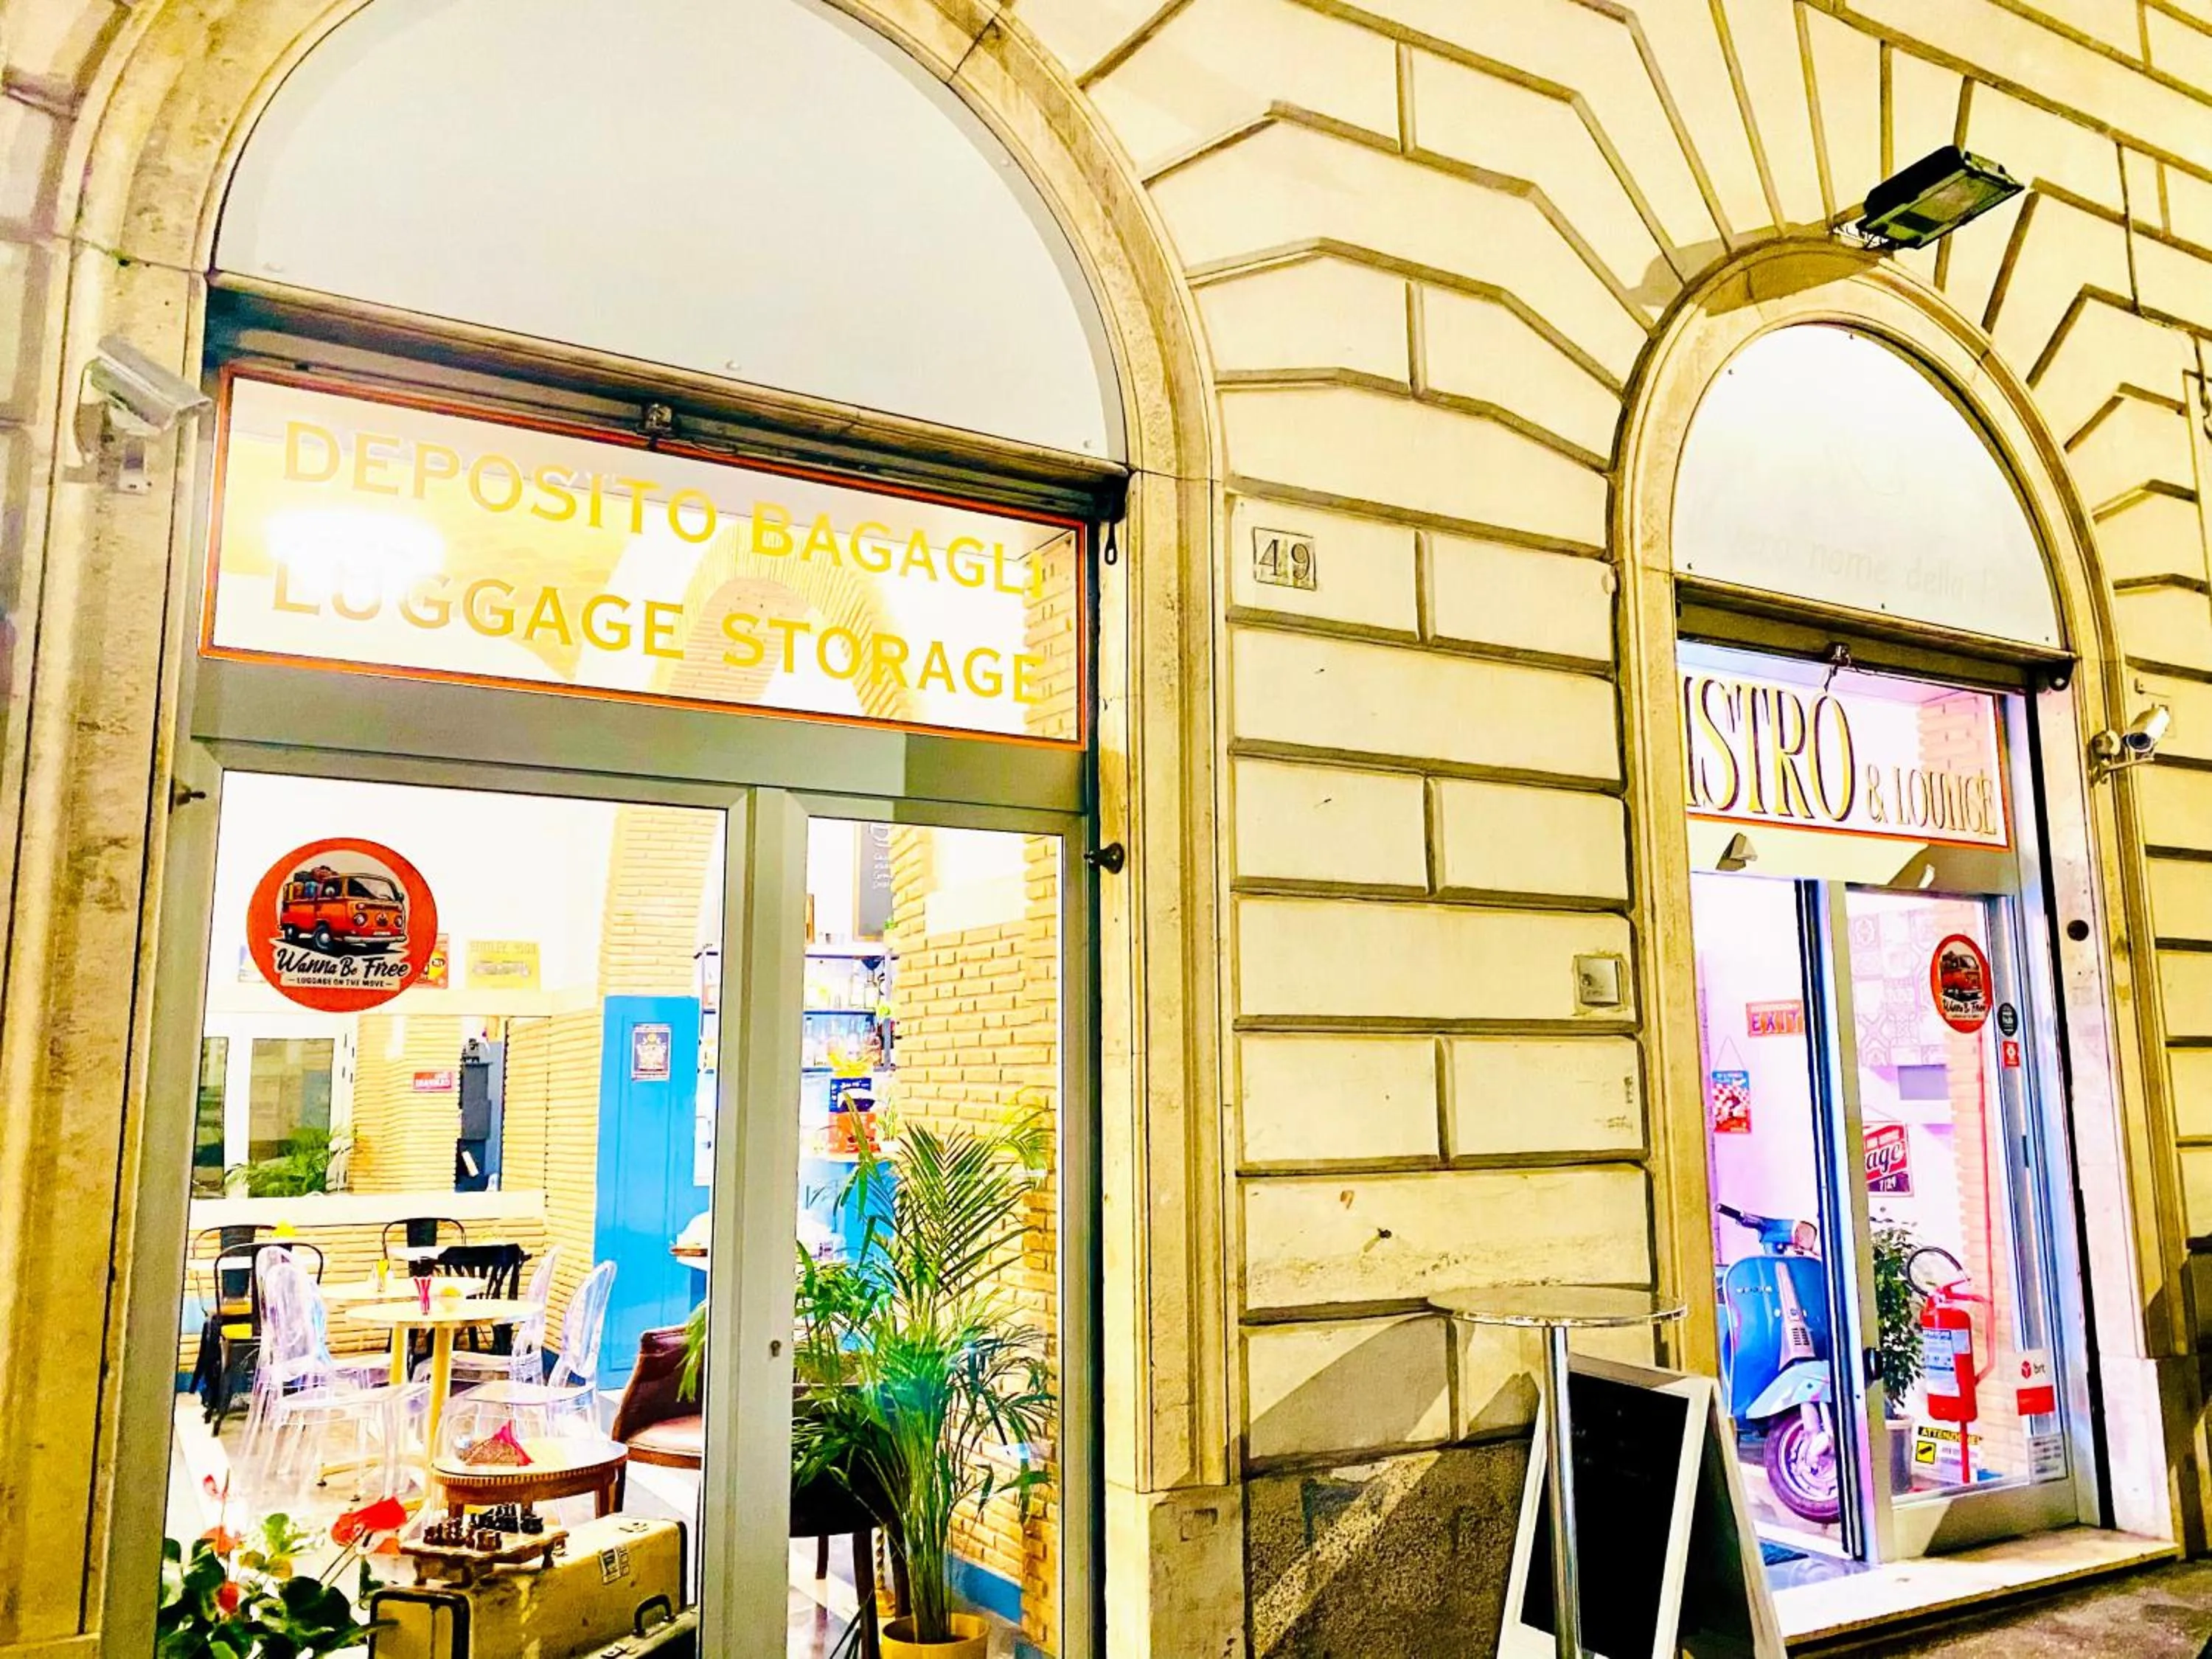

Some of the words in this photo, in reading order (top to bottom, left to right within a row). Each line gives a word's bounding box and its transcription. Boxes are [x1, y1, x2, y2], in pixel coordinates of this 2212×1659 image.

[284, 421, 715, 543] DEPOSITO
[752, 501, 1044, 598] BAGAGLI
[1259, 539, 1310, 580] 49
[272, 558, 684, 660] LUGGAGE
[722, 613, 1045, 704] STORAGE
[1866, 765, 1888, 824] &
[1894, 767, 1997, 835] LOUNGE
[277, 948, 337, 974] Wanna
[340, 957, 358, 976] Be
[362, 957, 408, 978] Free
[297, 977, 332, 985] LUGGAGE
[1752, 1010, 1801, 1032] EXIT
